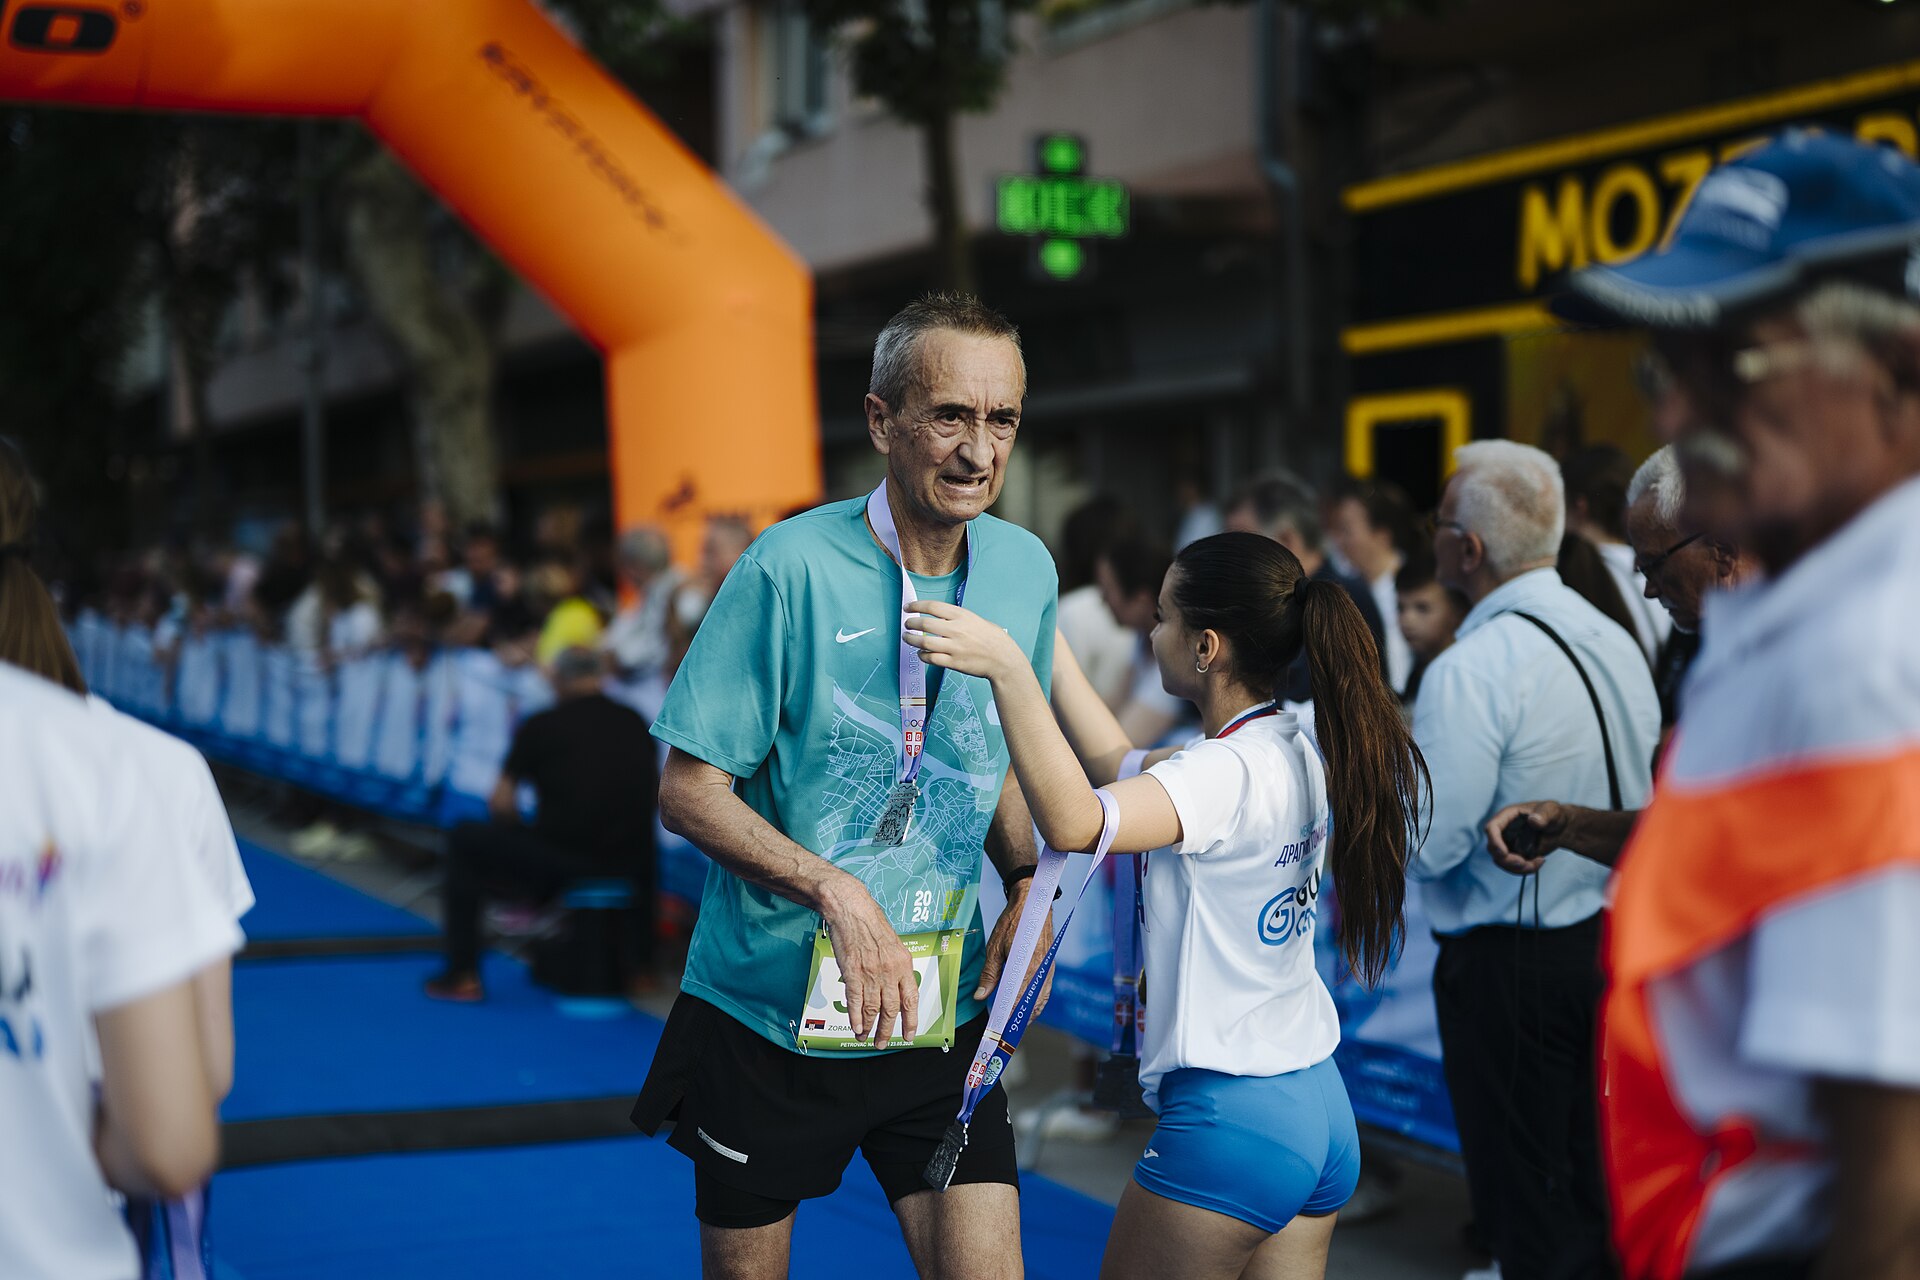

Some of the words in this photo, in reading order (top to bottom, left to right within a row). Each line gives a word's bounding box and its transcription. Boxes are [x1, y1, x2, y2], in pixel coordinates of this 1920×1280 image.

[1031, 885, 1050, 914] ТРКА
[1043, 853, 1060, 887] ДРАГ
[914, 890, 932, 906] 20
[912, 906, 930, 922] 24
[1025, 967, 1046, 1005] Млави
[1009, 1005, 1027, 1033] 2026.
